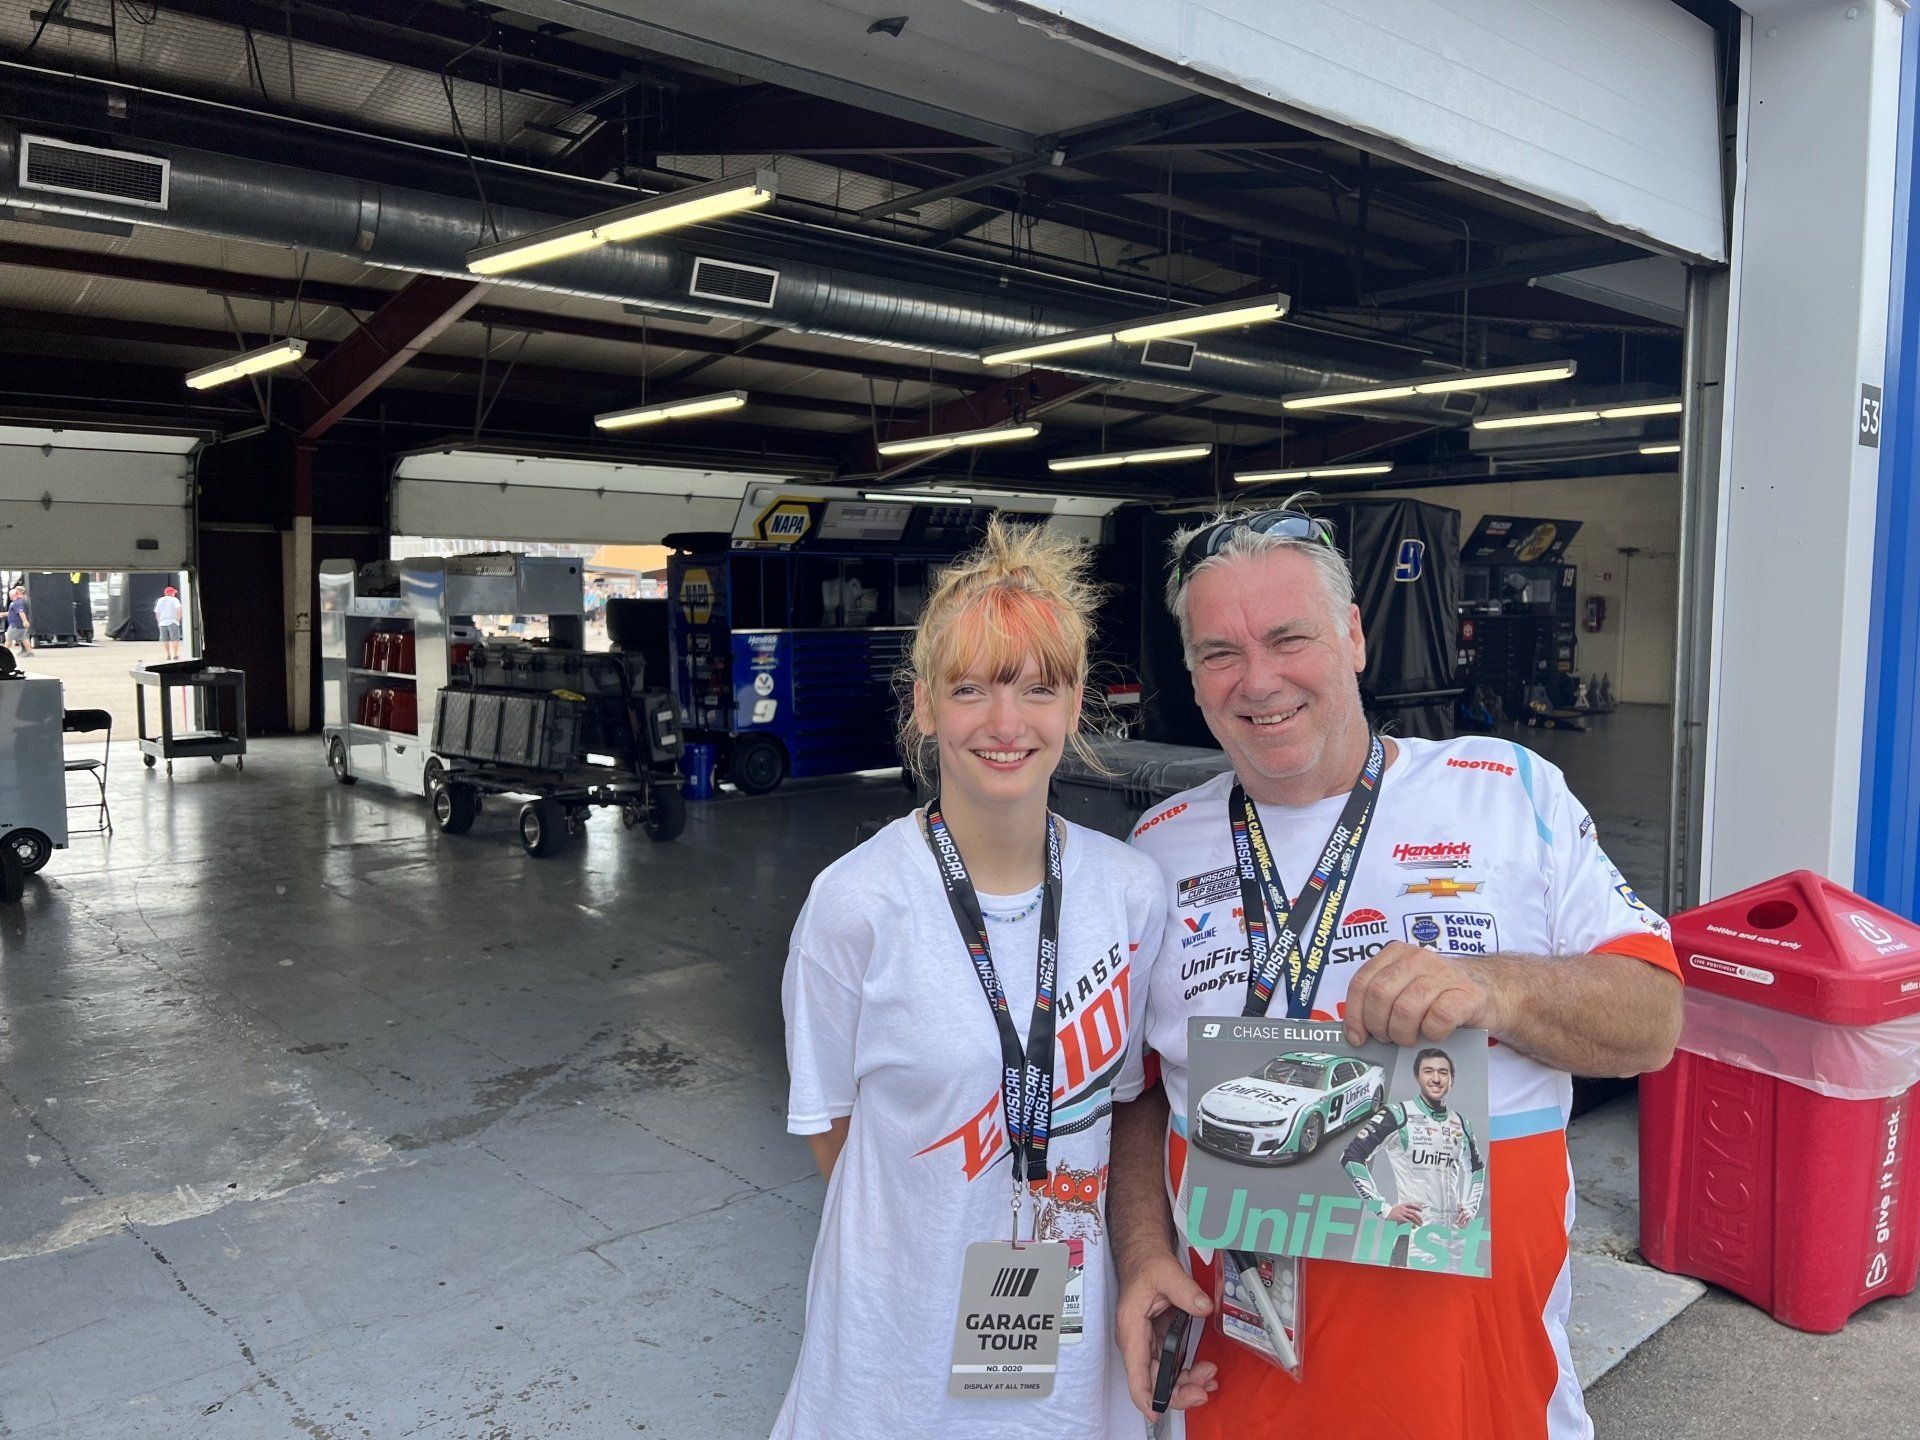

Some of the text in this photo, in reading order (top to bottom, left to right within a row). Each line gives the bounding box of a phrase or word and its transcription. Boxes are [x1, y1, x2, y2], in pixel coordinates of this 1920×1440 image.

[1861, 398, 1879, 434] 53
[770, 514, 805, 533] NAPA
[1394, 539, 1425, 582] 9
[752, 699, 778, 723] 9
[1446, 757, 1514, 777] HOOTERS
[1134, 802, 1188, 838] HOOTERS
[933, 827, 967, 881] NASCAR
[1048, 823, 1061, 880] NASCAR
[1234, 835, 1256, 880] NASCAR
[1318, 824, 1352, 876] NASCAR
[1392, 841, 1472, 861] Hendrick
[1187, 879, 1237, 899] CUP SERIES
[1199, 868, 1237, 885] NASCAR
[1204, 891, 1238, 903] CHAMPION
[1444, 914, 1491, 929] Kelley
[1446, 926, 1482, 939] Blue
[1181, 926, 1218, 949] VALVOLINE
[1449, 939, 1486, 953] Book
[1706, 924, 1802, 950] bottles and cans only
[1181, 947, 1250, 980] UniFirs
[1261, 928, 1297, 984] NASCAR
[1306, 946, 1324, 973] MIS
[1056, 942, 1122, 1021] HASE
[1184, 970, 1248, 1000] GOODYE
[1202, 1023, 1342, 1042] 9 CHASE ELLIOTT
[1005, 1067, 1021, 1129] NASCAR
[1022, 1064, 1041, 1125] NASCAR
[1217, 1083, 1299, 1106] UniFirst
[1345, 1083, 1371, 1105] UniFirst
[1328, 1094, 1344, 1124] 9
[1880, 1173, 1893, 1190] it
[1188, 1186, 1491, 1277] UniFirst
[1875, 1195, 1891, 1243] give
[1065, 1295, 1080, 1303] DAY
[965, 1313, 1055, 1331] GARAGE
[977, 1333, 1038, 1351] TOUR
